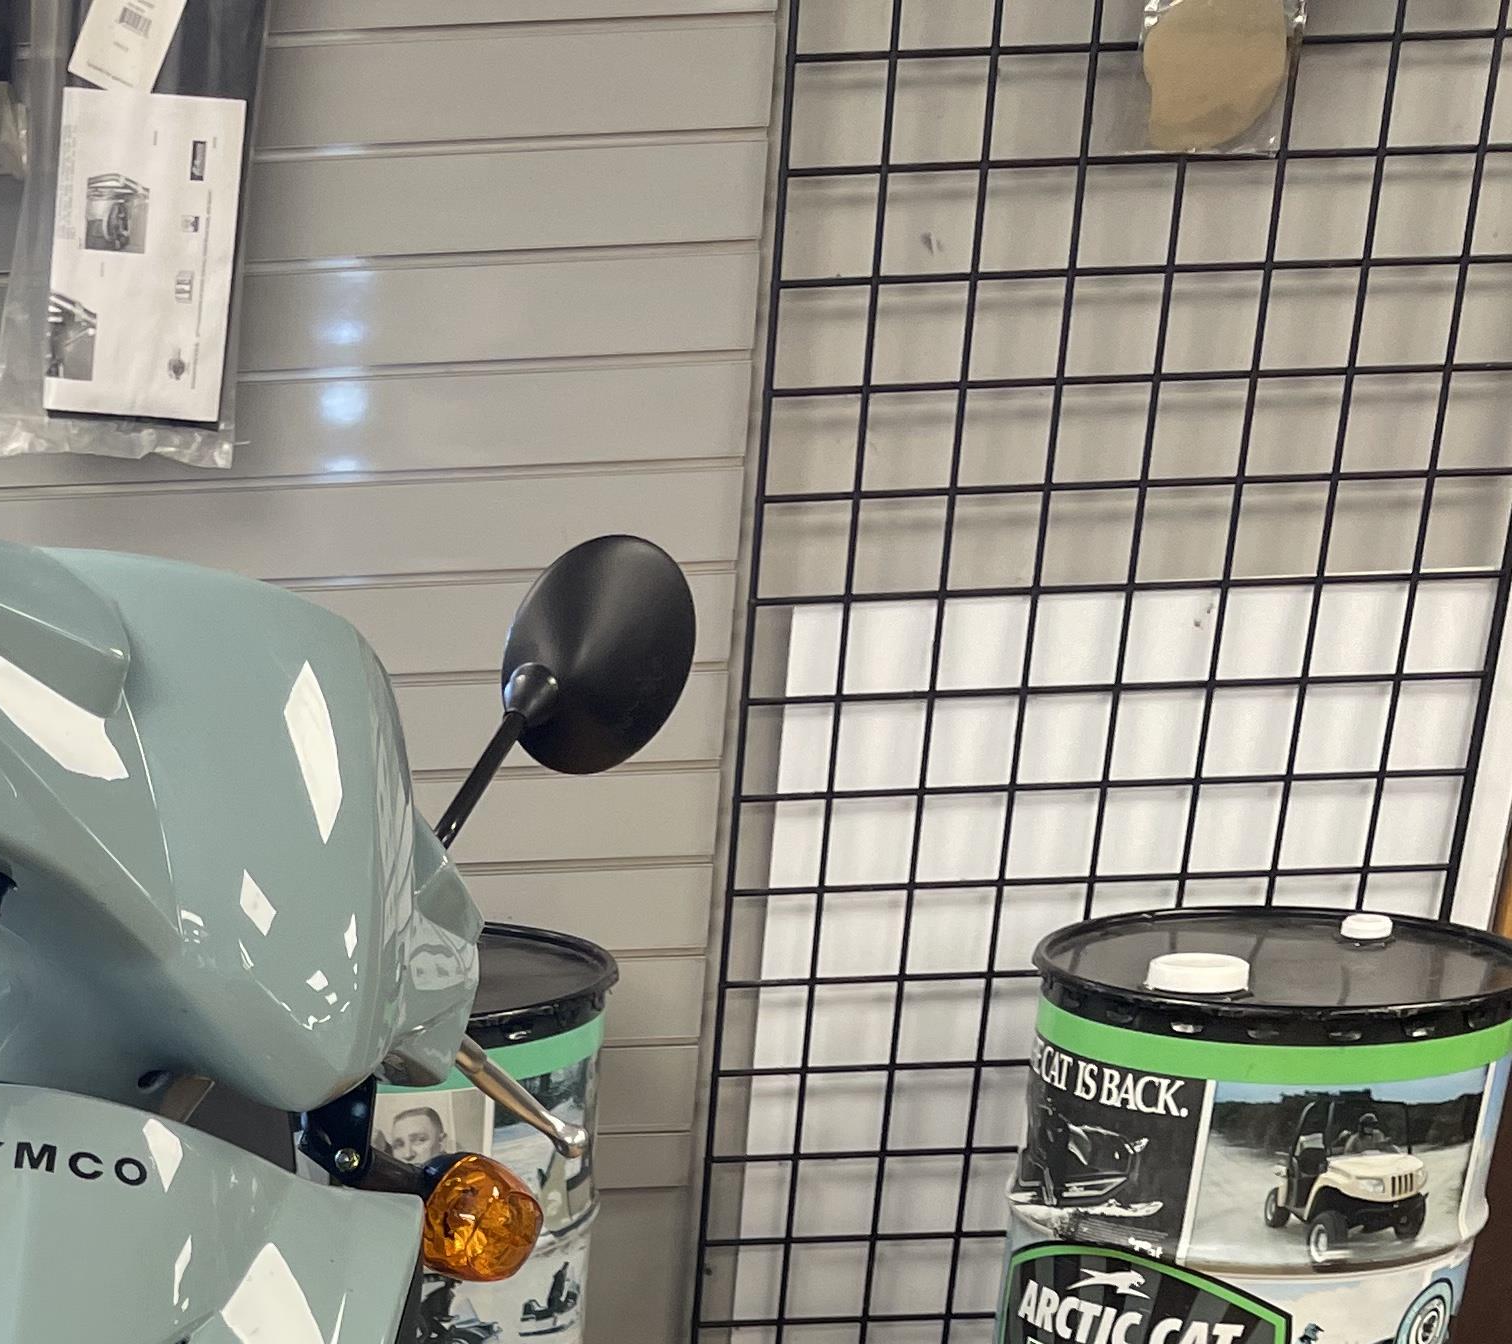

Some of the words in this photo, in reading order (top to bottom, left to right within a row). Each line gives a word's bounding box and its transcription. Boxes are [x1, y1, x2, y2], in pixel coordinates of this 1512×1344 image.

[1041, 1045, 1074, 1091] CAT
[1074, 1059, 1099, 1101] IS
[1099, 1067, 1189, 1118] BACK.
